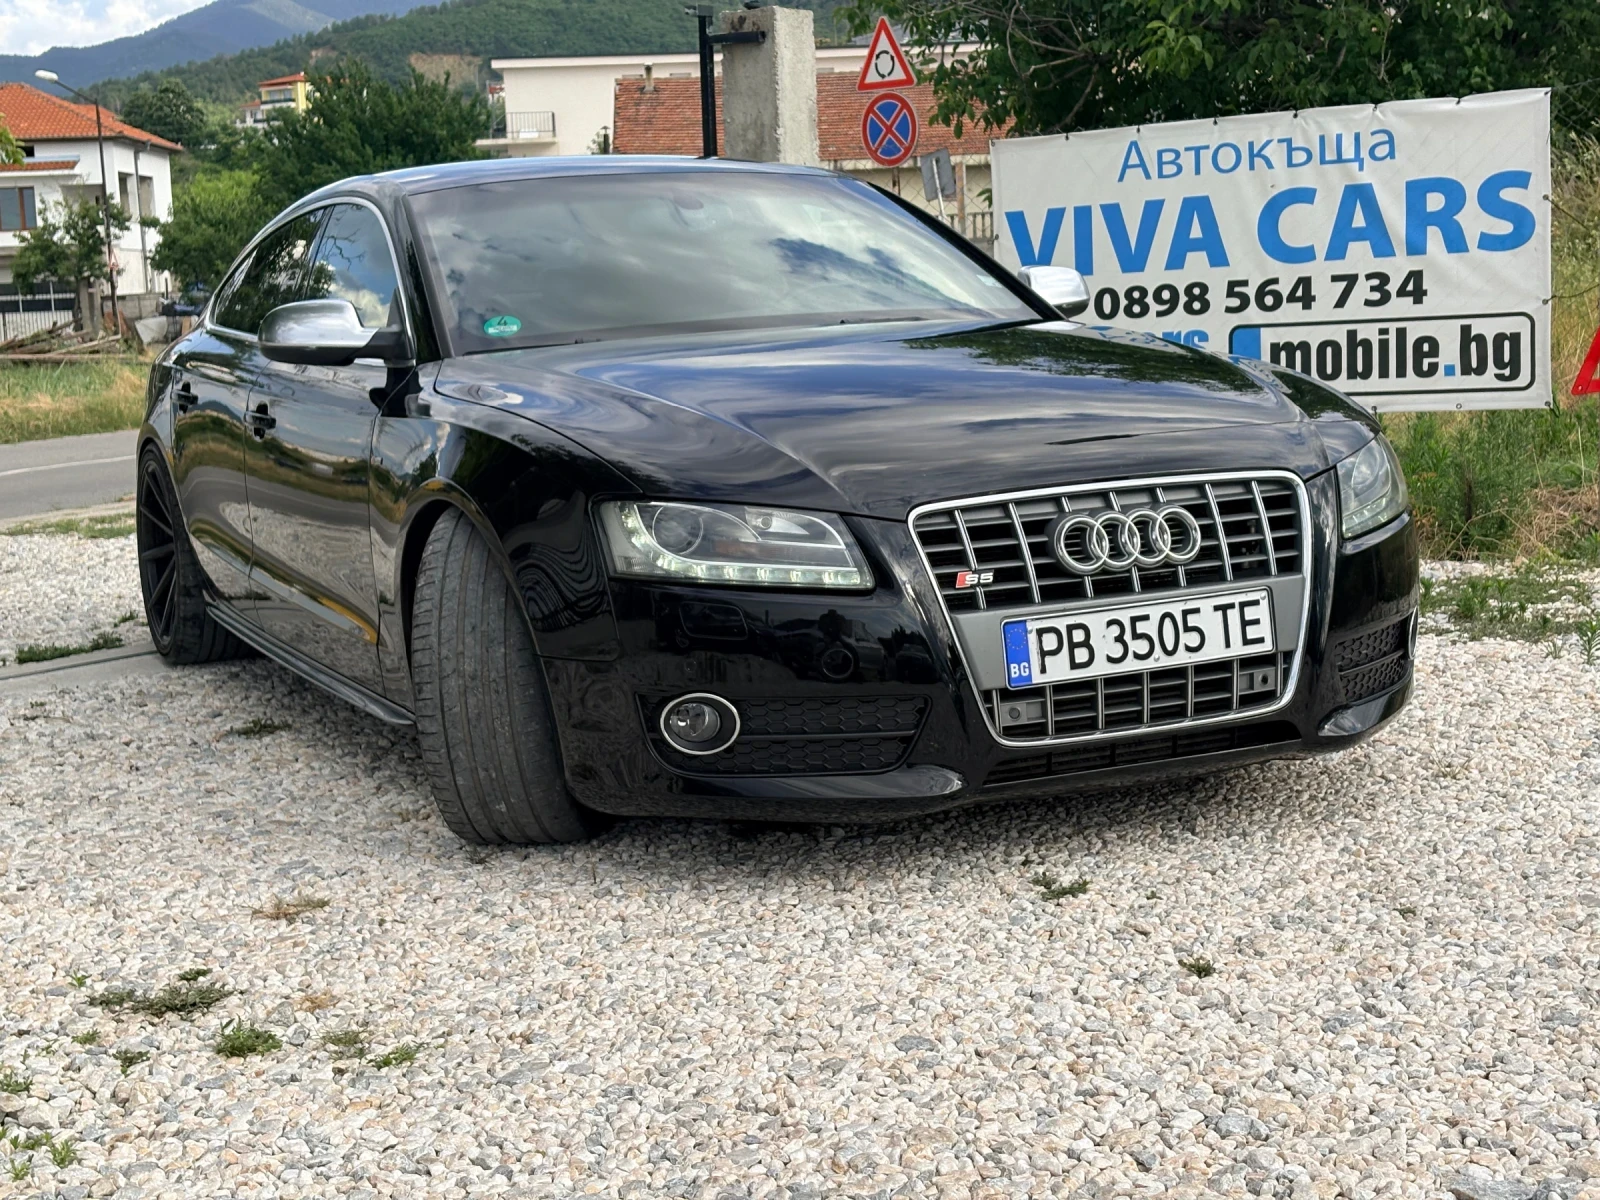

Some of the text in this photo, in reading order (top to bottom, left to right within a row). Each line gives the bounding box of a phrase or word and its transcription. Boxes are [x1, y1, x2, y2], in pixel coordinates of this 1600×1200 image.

[1117, 128, 1396, 183] Автокъща
[1004, 169, 1537, 277] VIVA CARS
[1093, 269, 1428, 321] 0898 564 734
[1269, 325, 1521, 382] mobile.bg
[964, 572, 994, 585] S5
[1035, 599, 1265, 675] PB 3505 TE
[1010, 662, 1030, 678] BG
